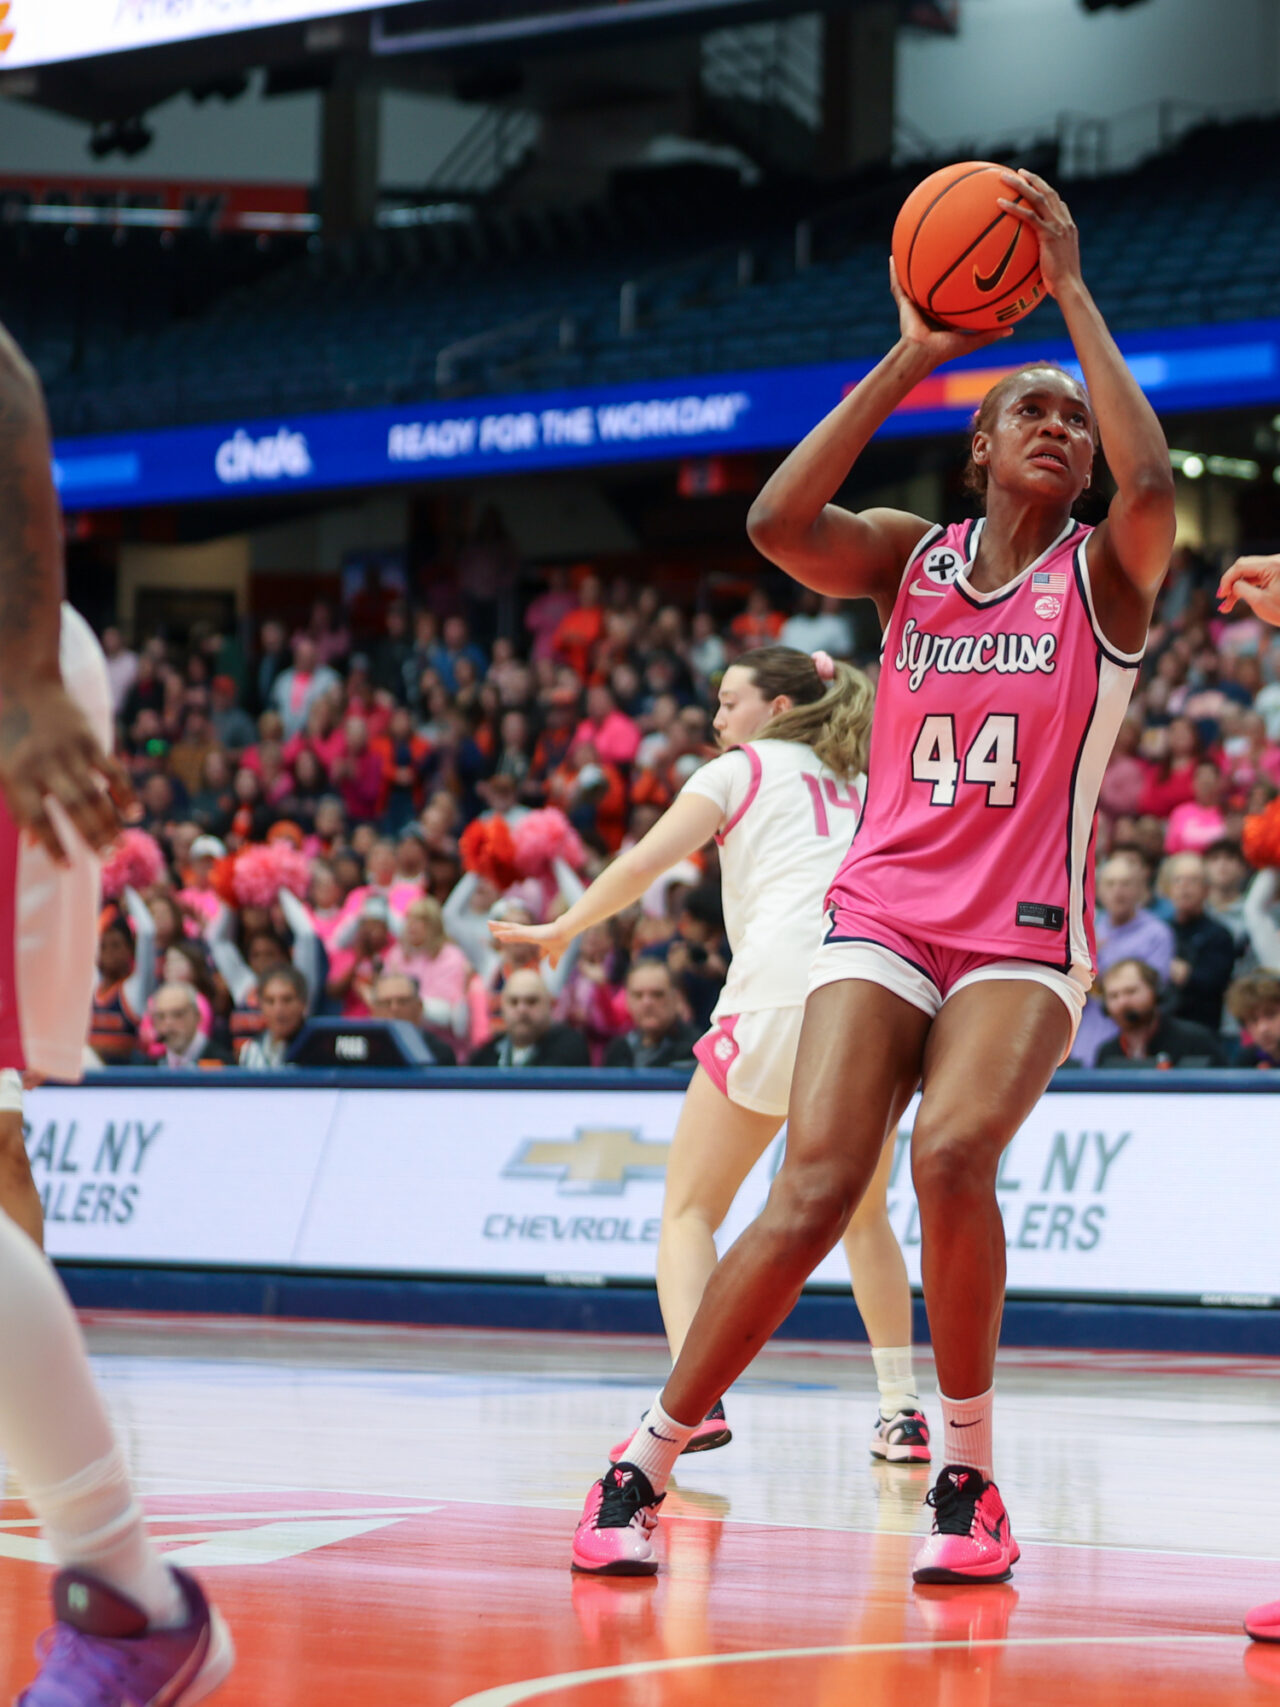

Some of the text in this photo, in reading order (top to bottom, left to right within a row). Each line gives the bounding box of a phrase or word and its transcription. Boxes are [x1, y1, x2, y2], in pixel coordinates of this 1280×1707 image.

[387, 419, 477, 462] READY
[479, 411, 540, 453] FOR
[541, 405, 595, 446] THE
[895, 617, 1057, 692] Syracuse
[911, 712, 1020, 808] 44
[800, 771, 862, 837] 14
[93, 1120, 163, 1173] NY
[1042, 1130, 1131, 1192] NY
[483, 1214, 661, 1242] CHEVROLE
